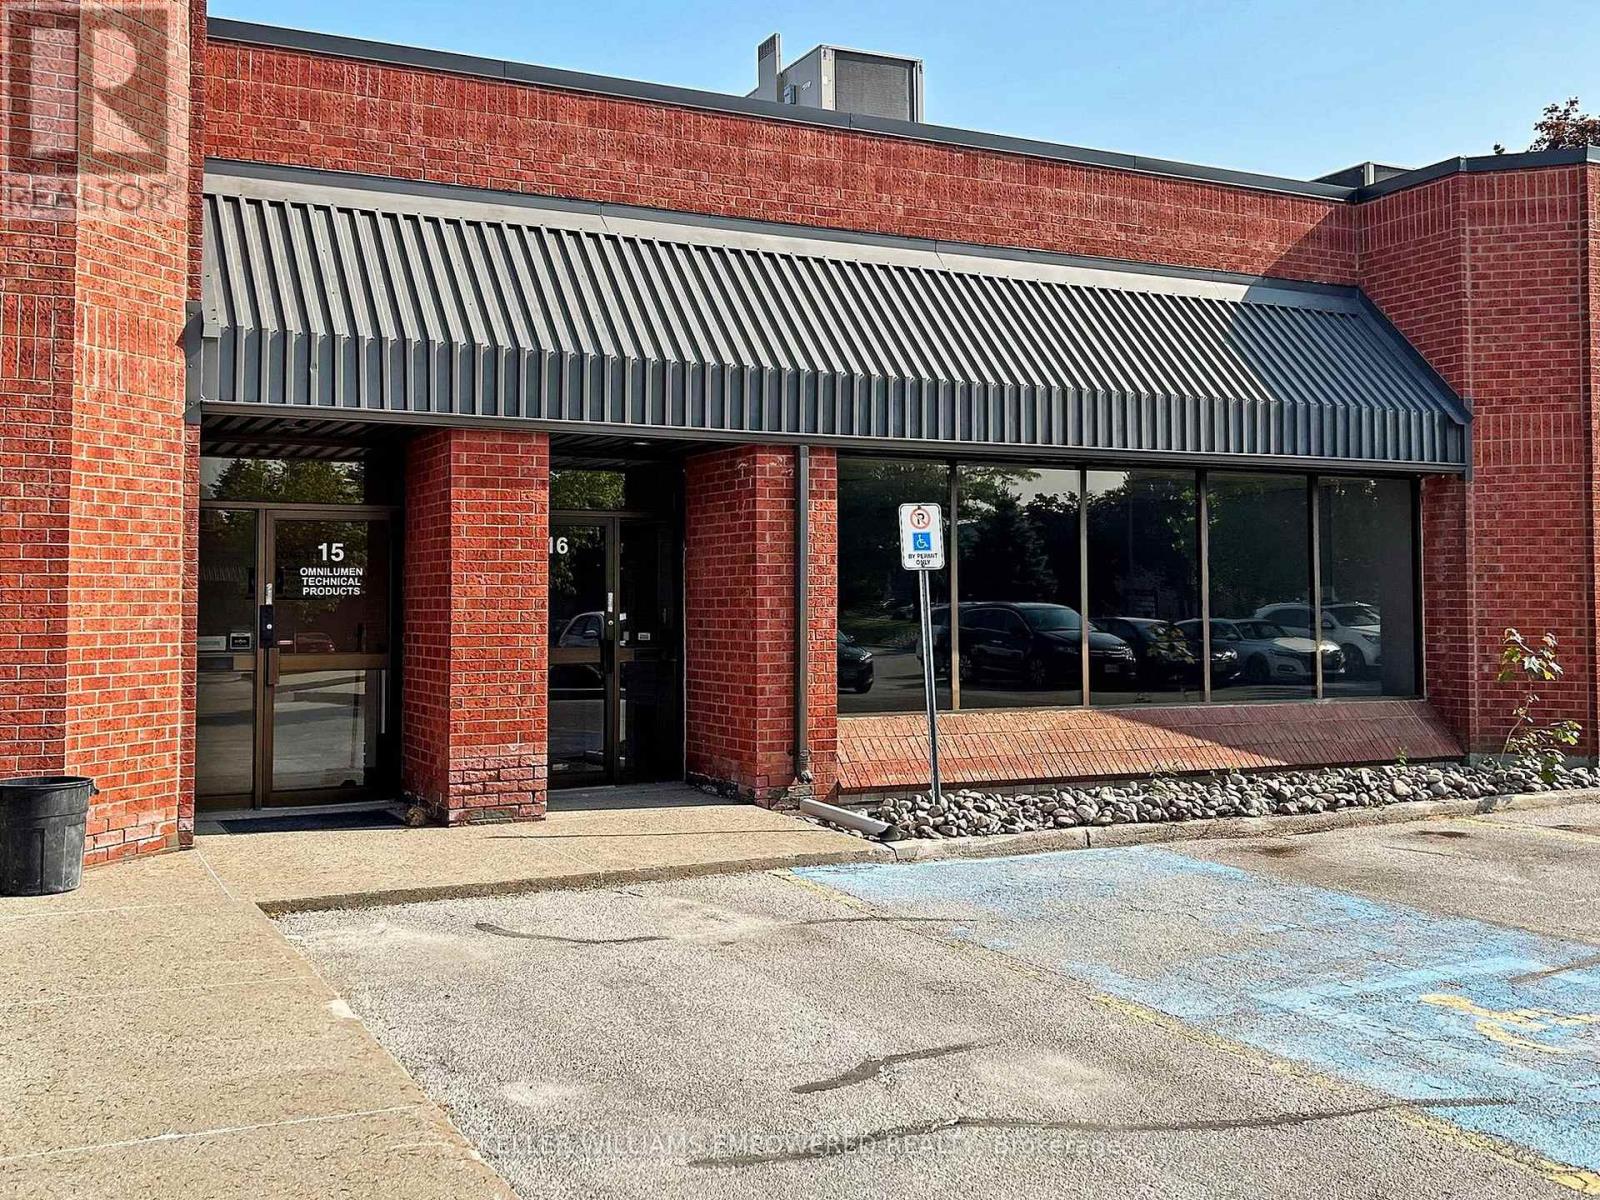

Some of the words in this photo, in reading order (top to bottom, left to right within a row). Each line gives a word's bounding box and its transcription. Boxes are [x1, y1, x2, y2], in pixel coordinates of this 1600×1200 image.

[318, 542, 345, 562] 15
[300, 567, 363, 576] OMNILUMEN
[302, 577, 361, 586] TECHNICAL
[302, 587, 361, 596] PRODUCTS
